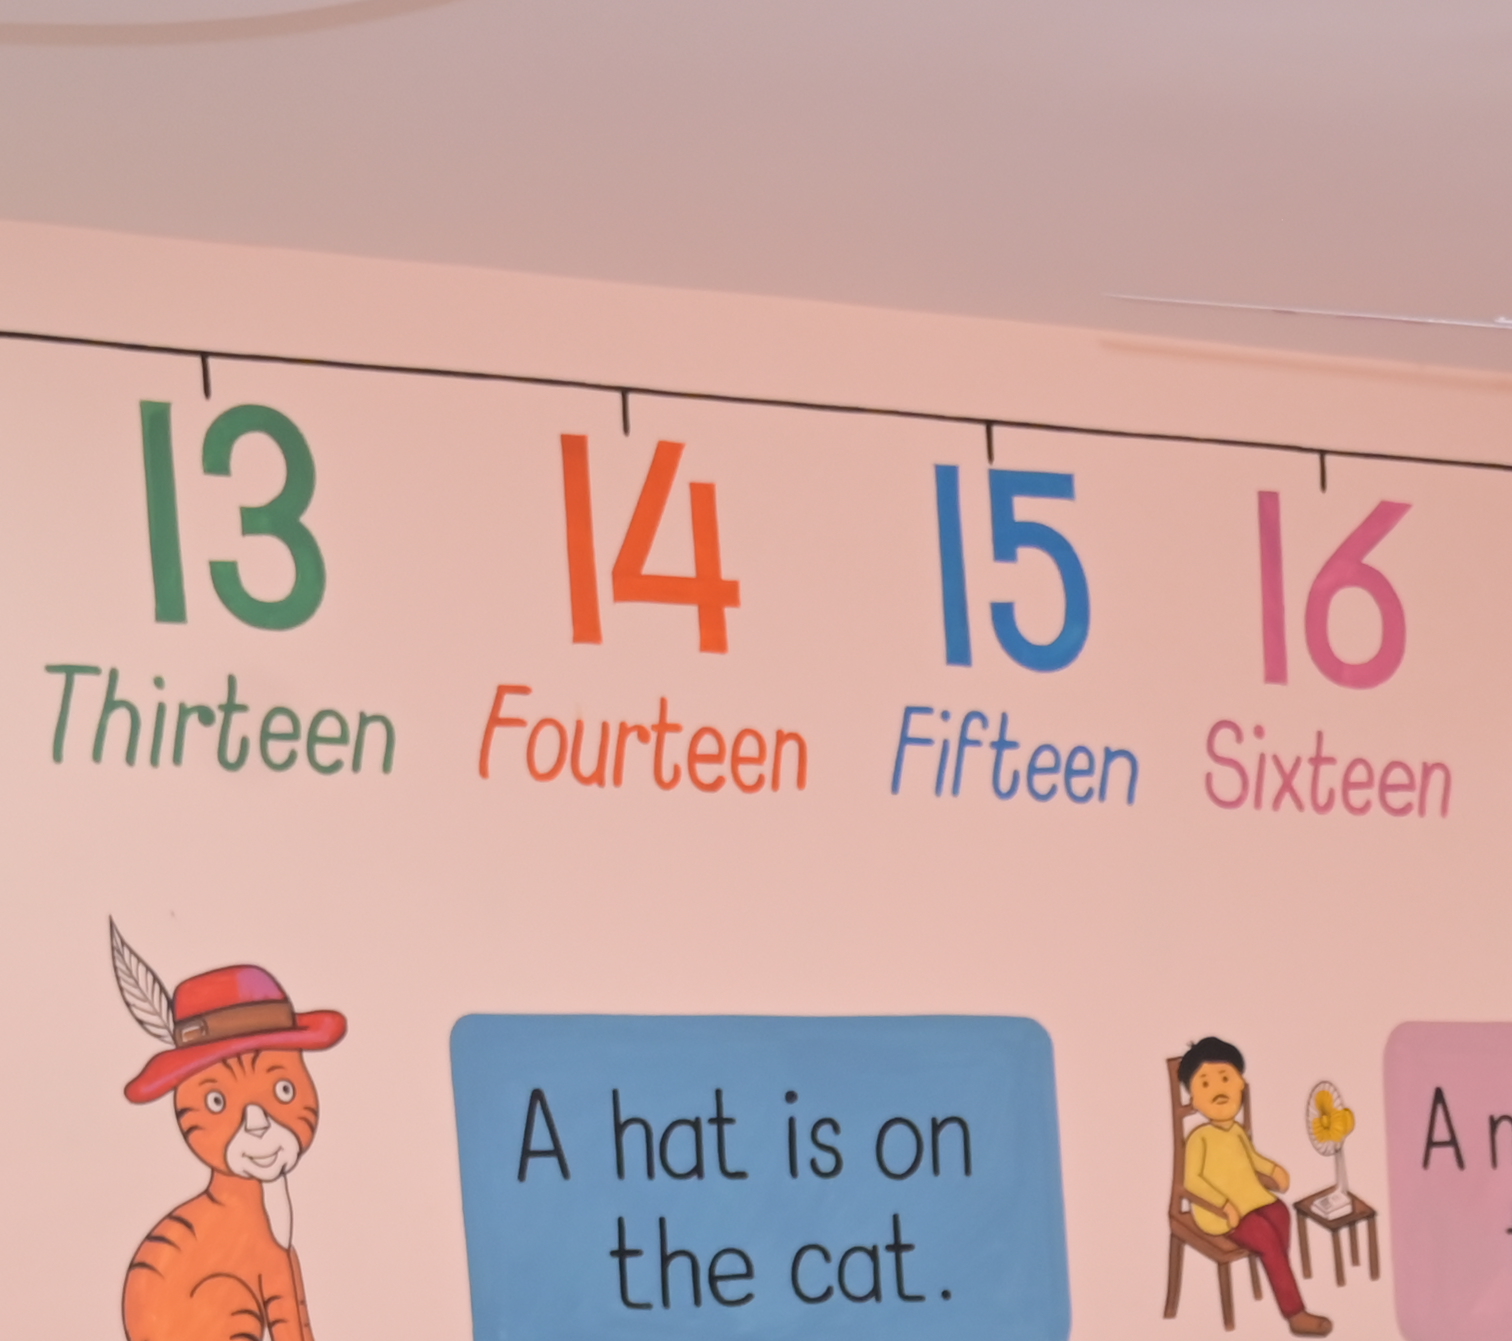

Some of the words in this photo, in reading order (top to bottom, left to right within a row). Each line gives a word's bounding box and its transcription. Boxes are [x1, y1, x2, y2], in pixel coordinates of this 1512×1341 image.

[140, 400, 326, 631] 13
[560, 433, 740, 653] 14
[935, 464, 1090, 672] 15
[1258, 491, 1411, 689] 16
[45, 664, 395, 775] Thirteen
[479, 684, 807, 793] Fourteen
[891, 706, 1139, 804] Fifteen
[1205, 719, 1451, 817] Sixteen
[518, 1088, 570, 1182] A
[612, 1088, 748, 1180] hat
[785, 1090, 843, 1179] is
[875, 1116, 971, 1180] on
[1423, 1087, 1464, 1170] A
[610, 1217, 754, 1309] the
[791, 1213, 951, 1304] cat.
